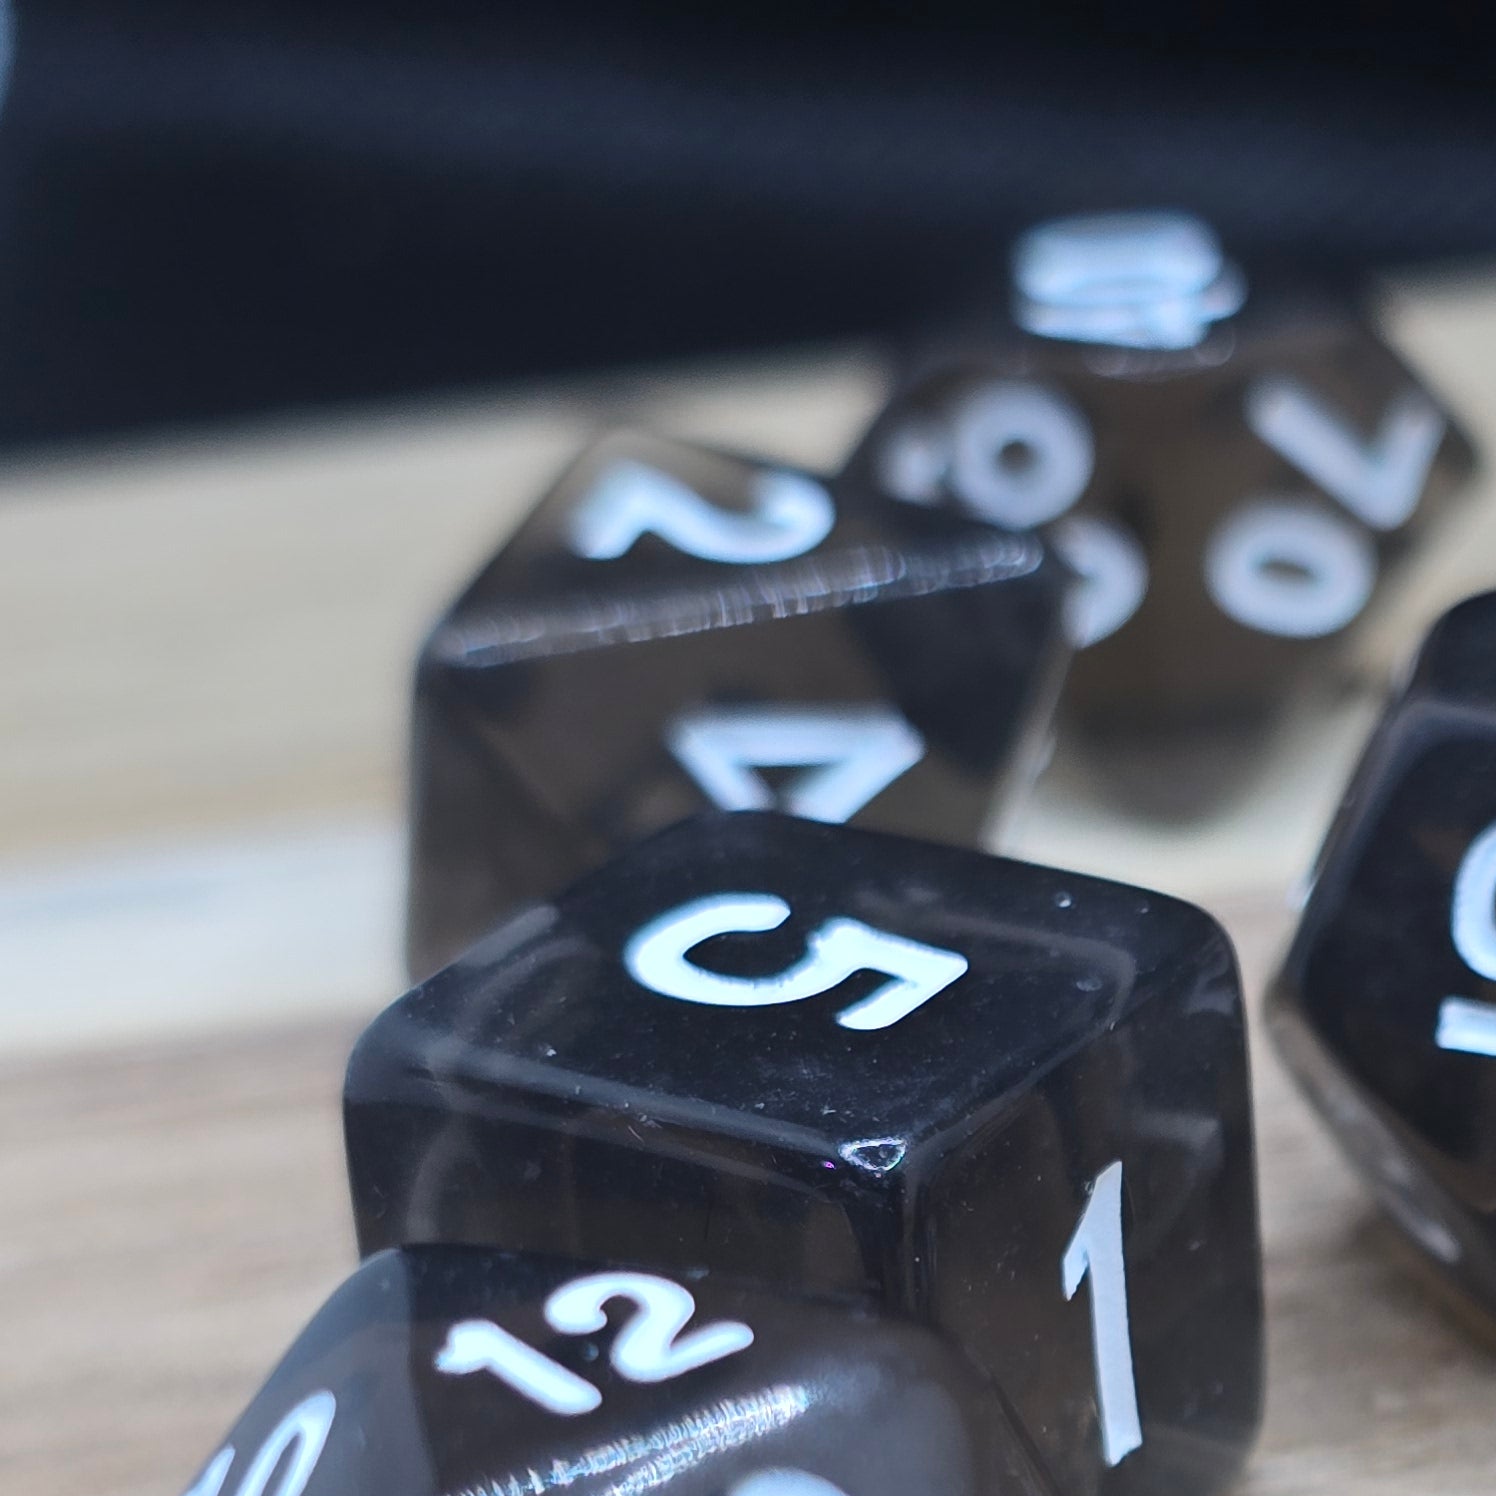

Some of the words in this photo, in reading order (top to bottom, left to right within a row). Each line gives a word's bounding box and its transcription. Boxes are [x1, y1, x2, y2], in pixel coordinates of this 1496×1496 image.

[570, 458, 838, 564] 2
[1207, 383, 1442, 638] 70
[625, 894, 968, 1031] 5
[434, 1270, 757, 1416] 12
[1063, 1160, 1143, 1467] 1
